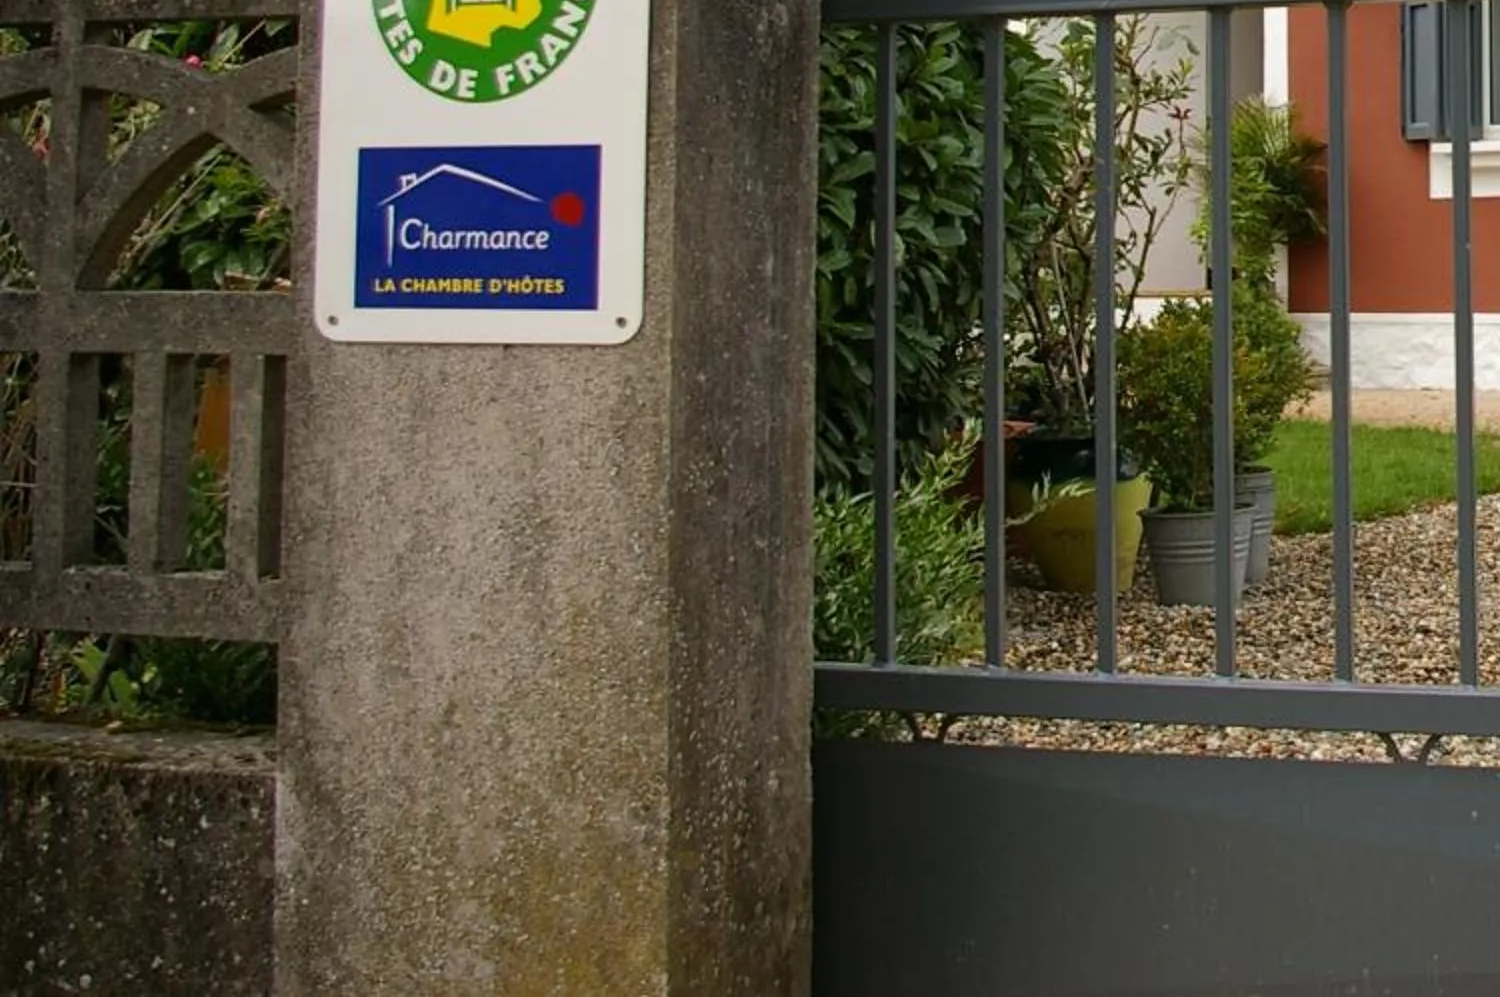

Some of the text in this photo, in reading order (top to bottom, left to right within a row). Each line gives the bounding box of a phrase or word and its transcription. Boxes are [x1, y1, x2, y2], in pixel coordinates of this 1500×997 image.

[428, 59, 478, 99] DE
[401, 217, 550, 250] Charmance
[373, 274, 566, 294] LA CHAMBRE D'HÔTES
